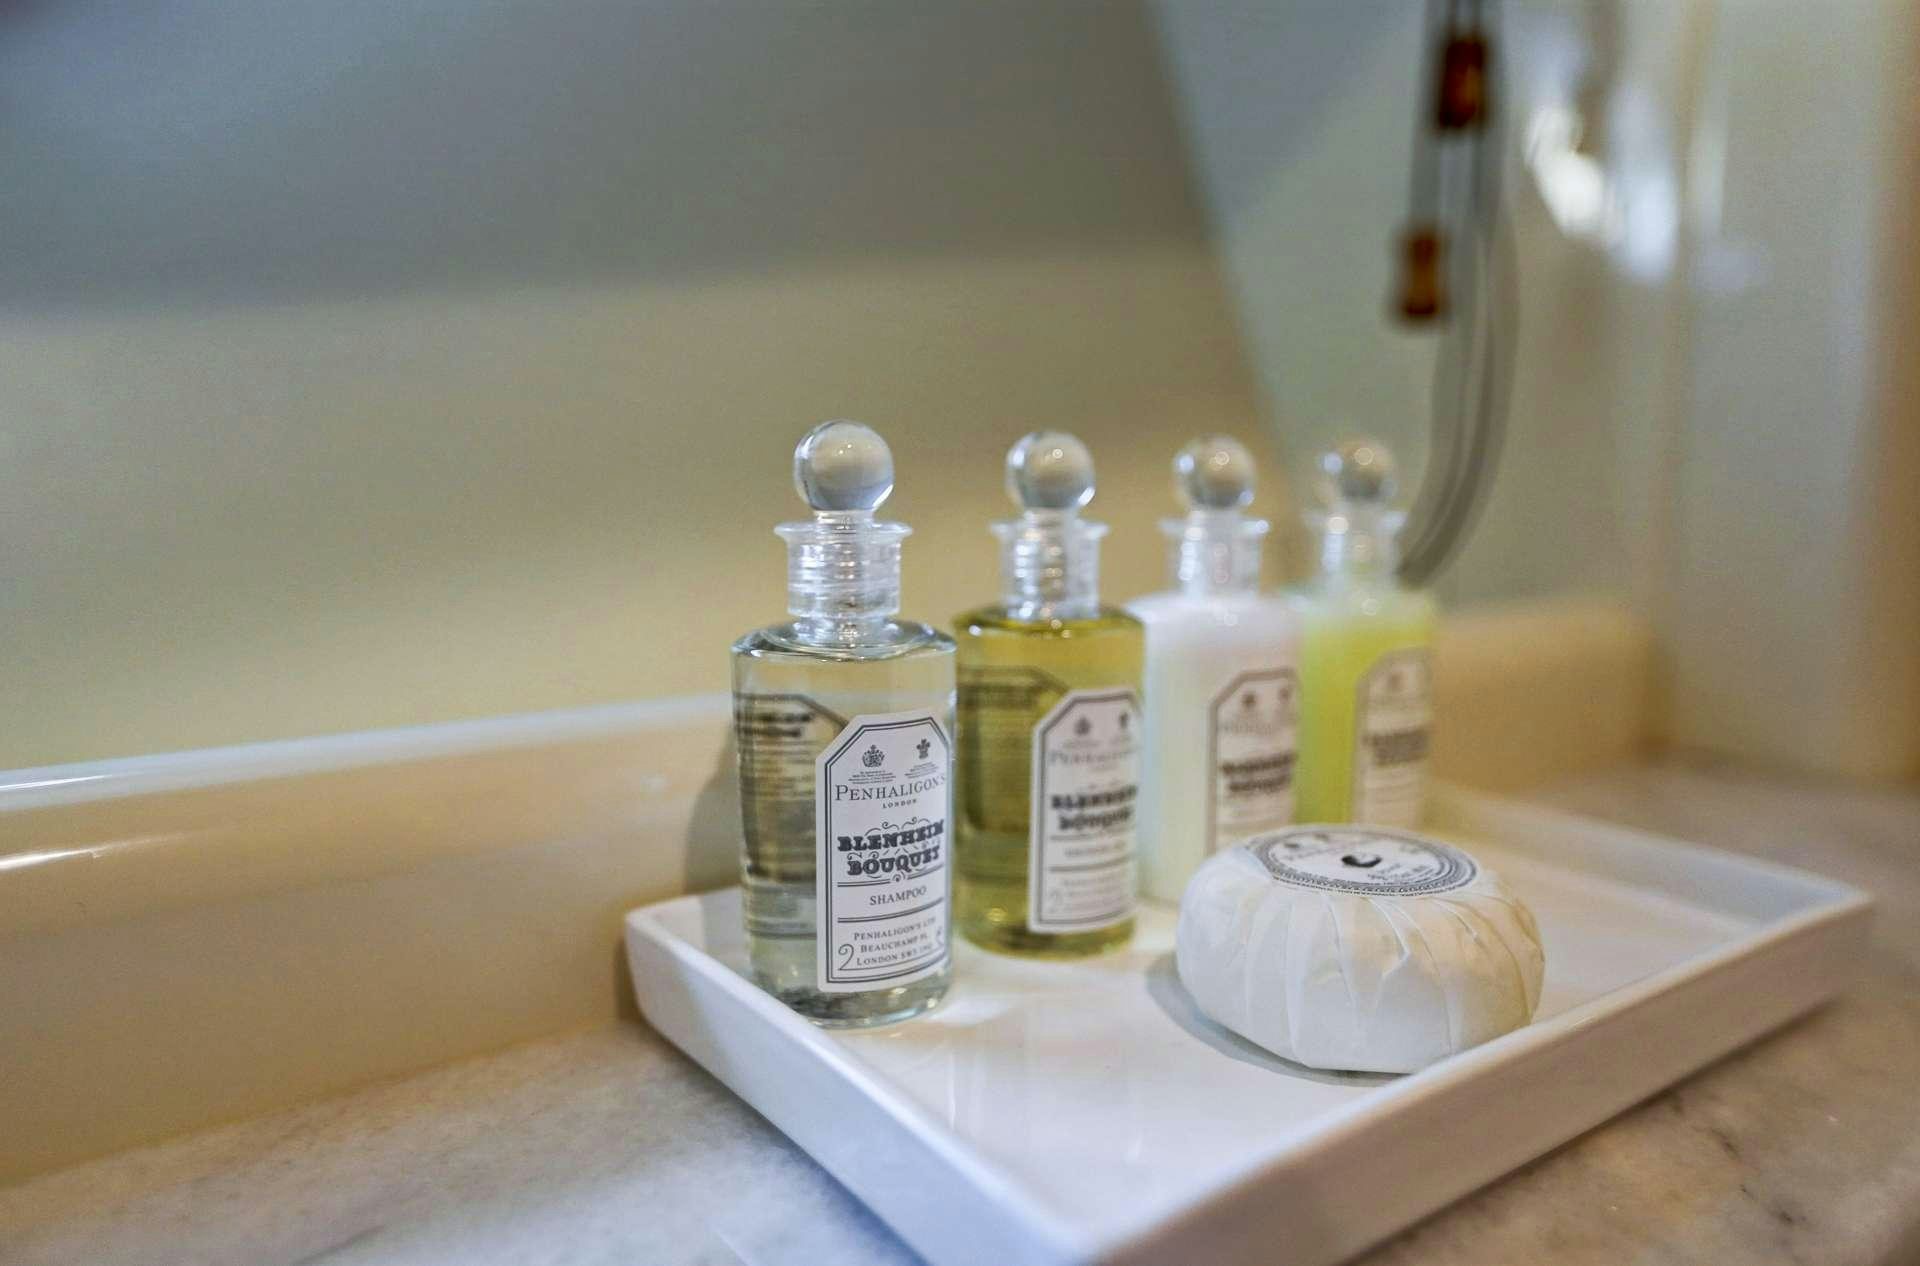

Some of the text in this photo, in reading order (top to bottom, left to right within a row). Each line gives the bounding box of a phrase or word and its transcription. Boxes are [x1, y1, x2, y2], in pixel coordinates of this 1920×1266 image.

[881, 799, 918, 809] LONDON
[837, 818, 945, 852] BLENHEIM
[847, 844, 941, 876] BOUQUET
[869, 885, 928, 907] SHAMPOO
[856, 953, 898, 966] LONDON
